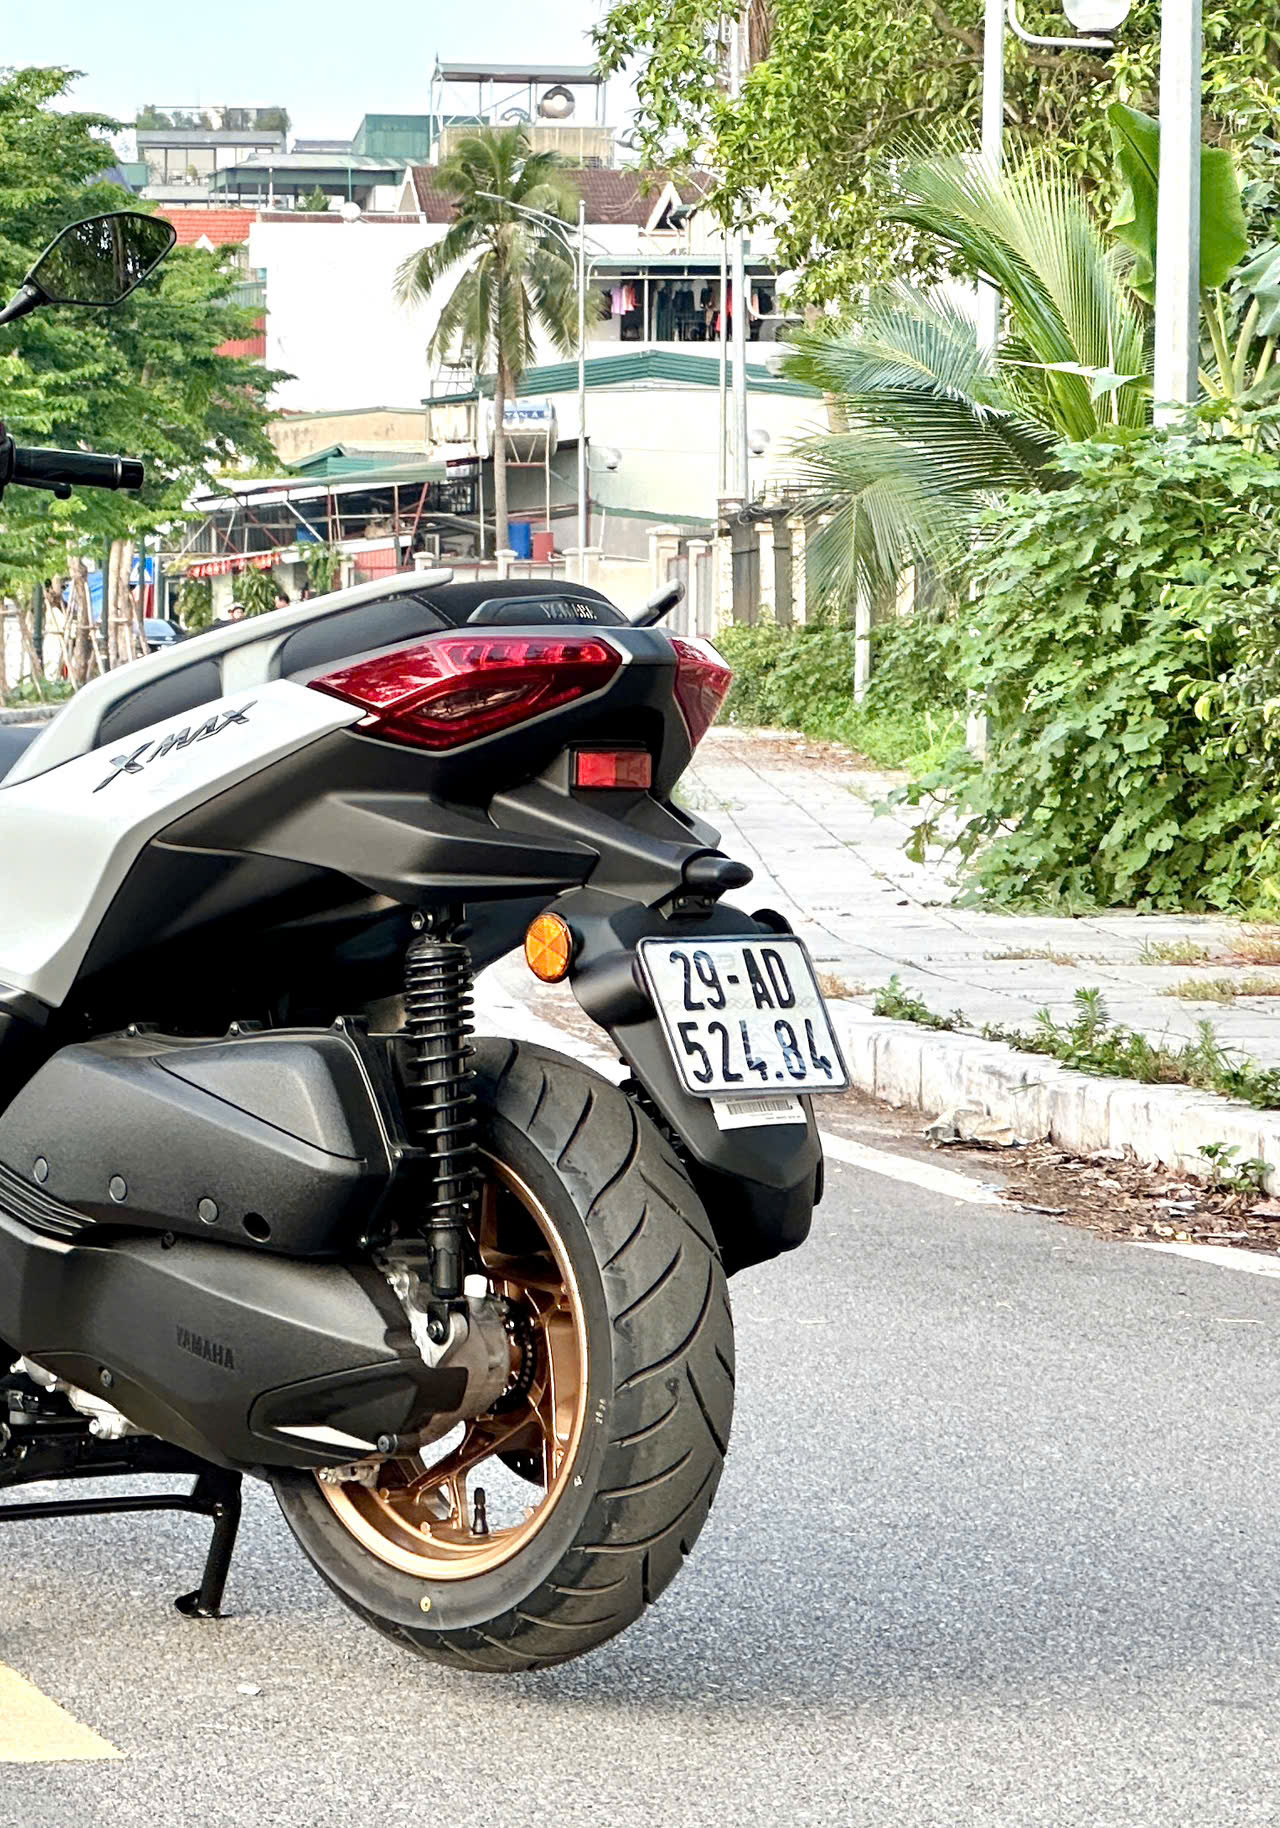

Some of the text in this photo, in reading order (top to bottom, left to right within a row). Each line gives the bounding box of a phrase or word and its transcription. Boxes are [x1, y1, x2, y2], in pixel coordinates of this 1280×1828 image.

[670, 948, 796, 1011] 29-AD
[677, 1018, 833, 1083] 524.84
[176, 1324, 235, 1370] YAMAHA
